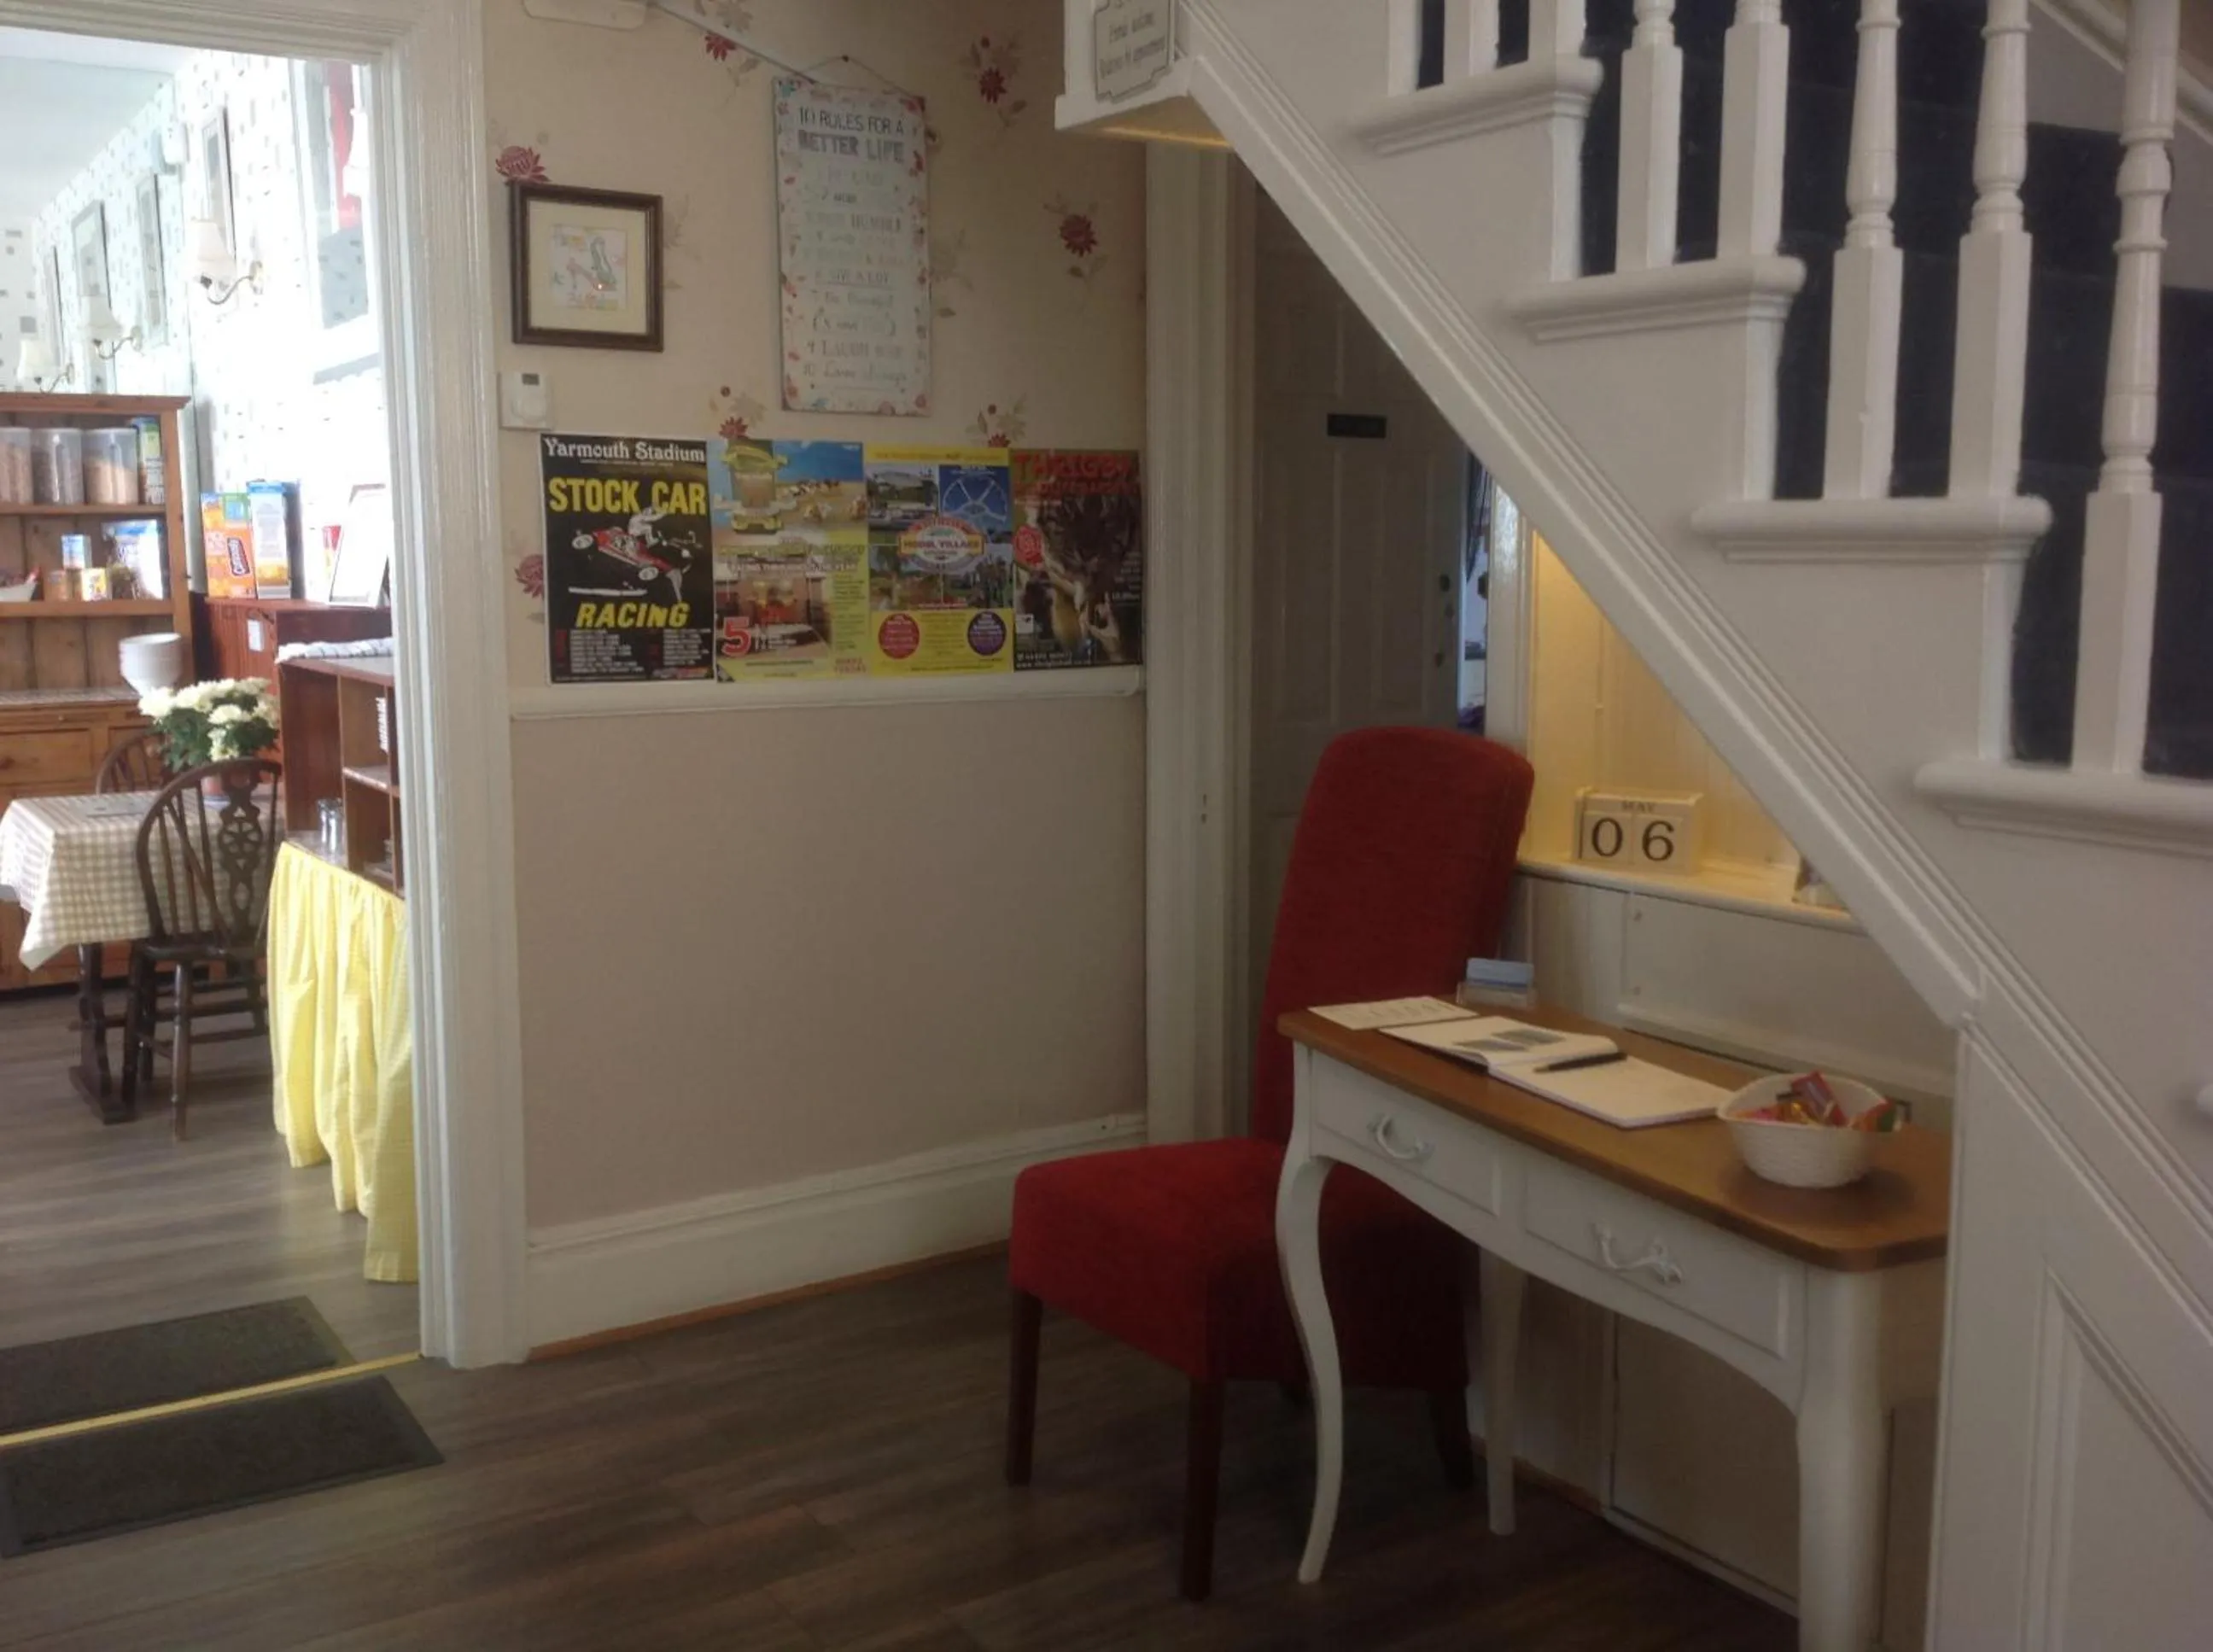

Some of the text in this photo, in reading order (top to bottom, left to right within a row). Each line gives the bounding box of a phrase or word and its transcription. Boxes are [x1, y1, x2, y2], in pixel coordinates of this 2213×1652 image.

[819, 109, 864, 132] RULES
[867, 115, 891, 135] FOR
[895, 119, 905, 137] A
[798, 130, 905, 164] BETTER LIFE
[543, 436, 706, 463] Yarmouth Stadium
[548, 477, 707, 515] STOCK CAR
[575, 602, 691, 628] RACING
[1622, 801, 1656, 812] MAY
